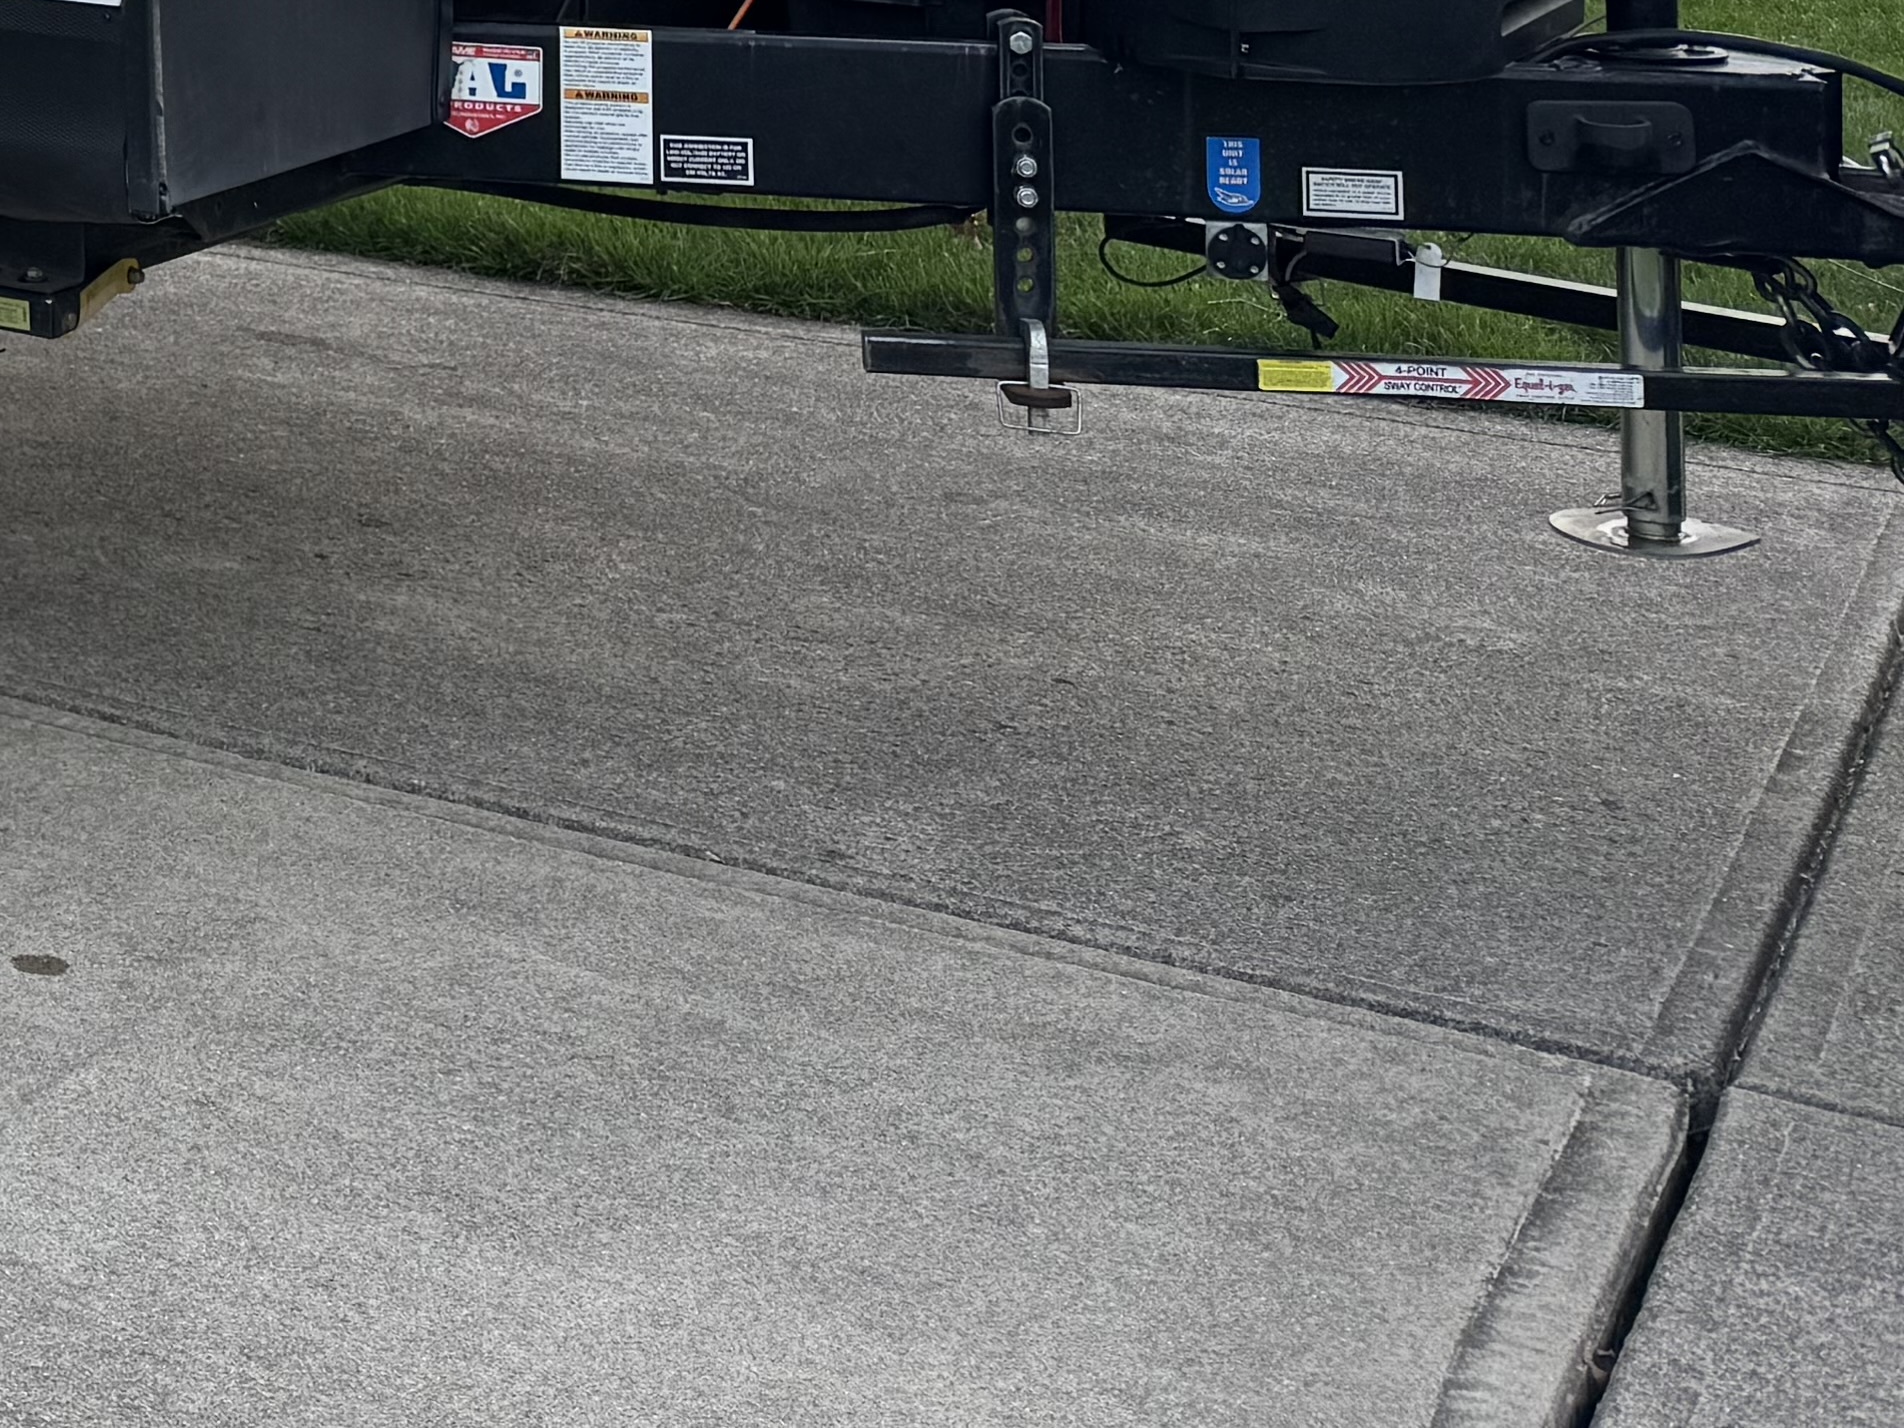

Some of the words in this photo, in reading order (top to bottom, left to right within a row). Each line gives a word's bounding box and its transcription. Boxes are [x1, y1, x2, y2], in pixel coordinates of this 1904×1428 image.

[583, 30, 638, 41] WARNING
[451, 61, 527, 100] AL
[584, 91, 639, 102] WARNING
[453, 101, 522, 113] RODUCTS
[1219, 167, 1248, 176] SOLAR
[1219, 176, 1248, 185] READY
[1394, 365, 1447, 378] 4-POINT
[1383, 380, 1412, 392] SWAY
[1413, 382, 1460, 394] CONTROL
